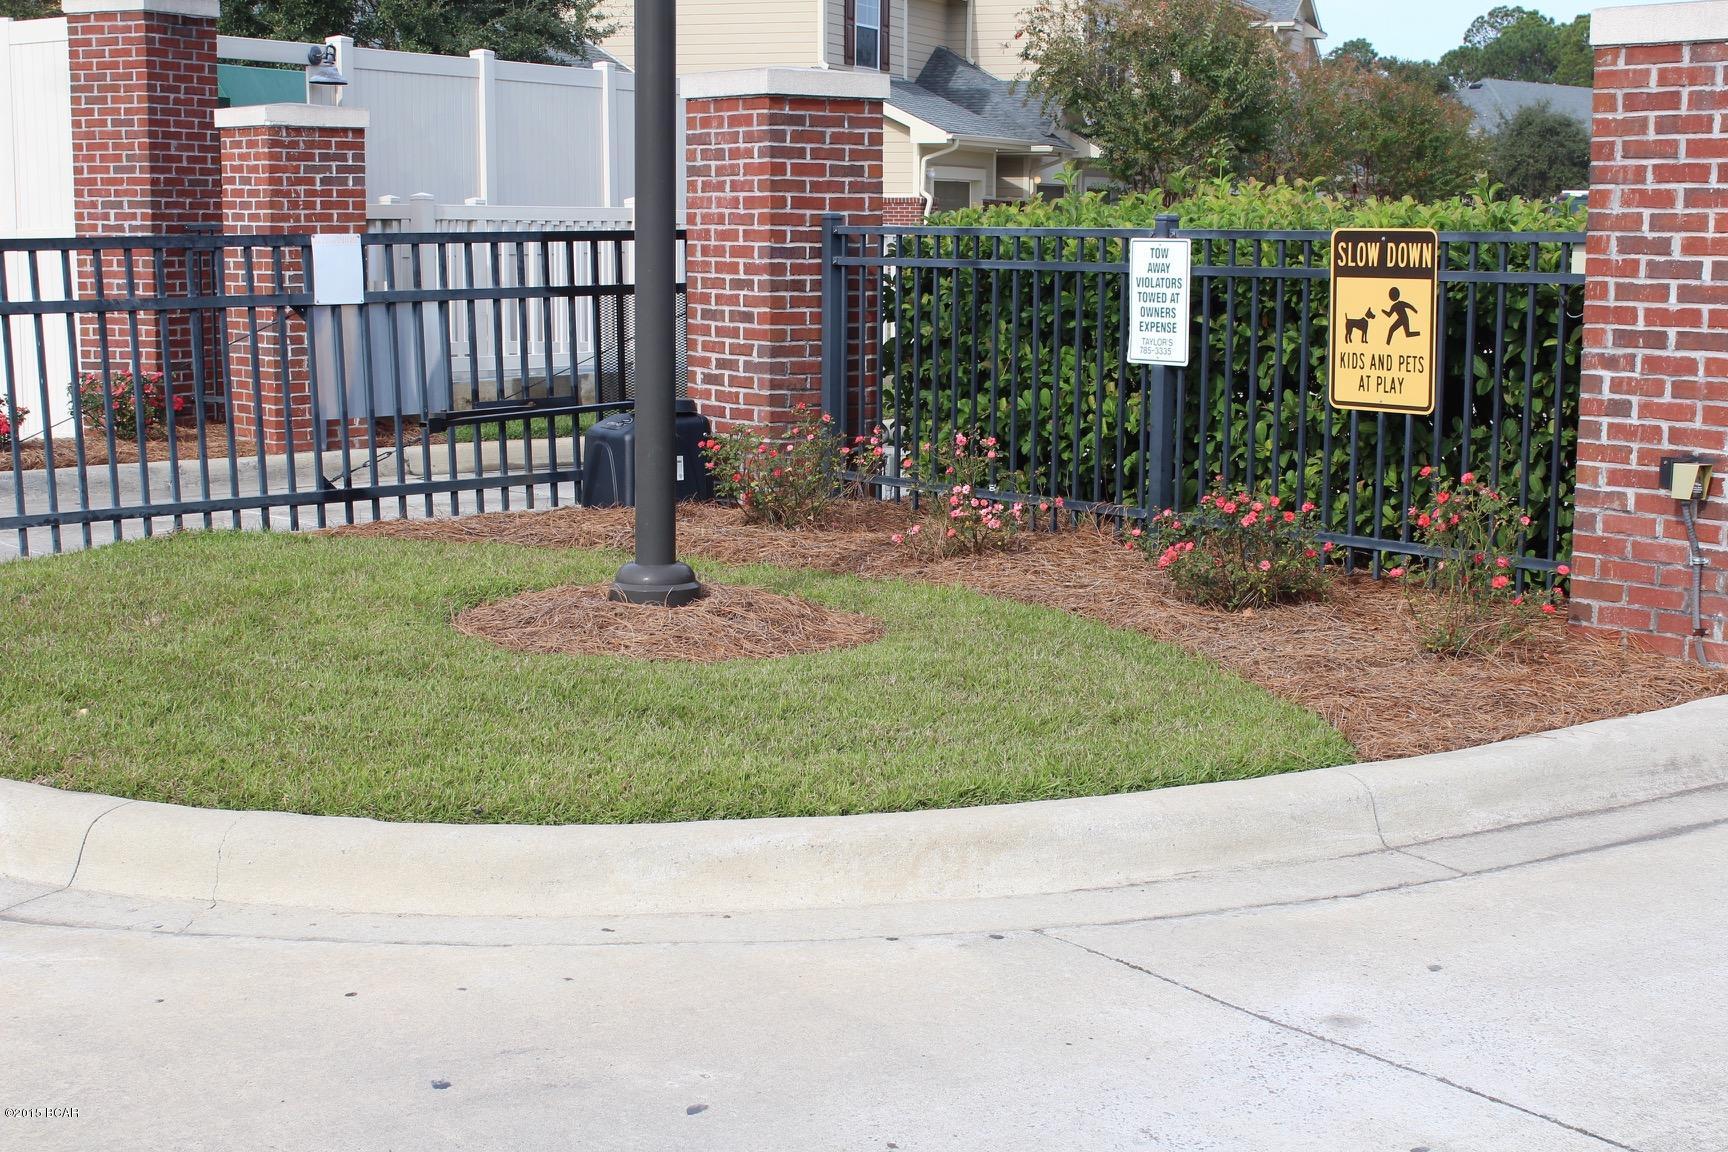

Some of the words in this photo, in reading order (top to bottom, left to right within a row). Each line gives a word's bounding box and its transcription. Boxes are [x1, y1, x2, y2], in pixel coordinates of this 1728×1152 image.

[1150, 247, 1169, 259] TOW
[1337, 241, 1380, 268] SLOW
[1386, 242, 1432, 269] DOWN
[1147, 262, 1171, 274] AWAY
[1136, 276, 1183, 289] VIOLATORS
[1137, 291, 1167, 303] TOWED
[1169, 292, 1180, 304] AT
[1140, 306, 1177, 319] OWNERS
[1139, 321, 1177, 333] EXPENSE
[1142, 337, 1173, 346] TAYLOR'S
[1139, 347, 1172, 355] 785-3335
[1340, 351, 1365, 370] KIDS
[1369, 353, 1393, 371] AND
[1398, 355, 1424, 374] PETS
[1358, 374, 1371, 392] AT
[1376, 376, 1405, 395] PLAY
